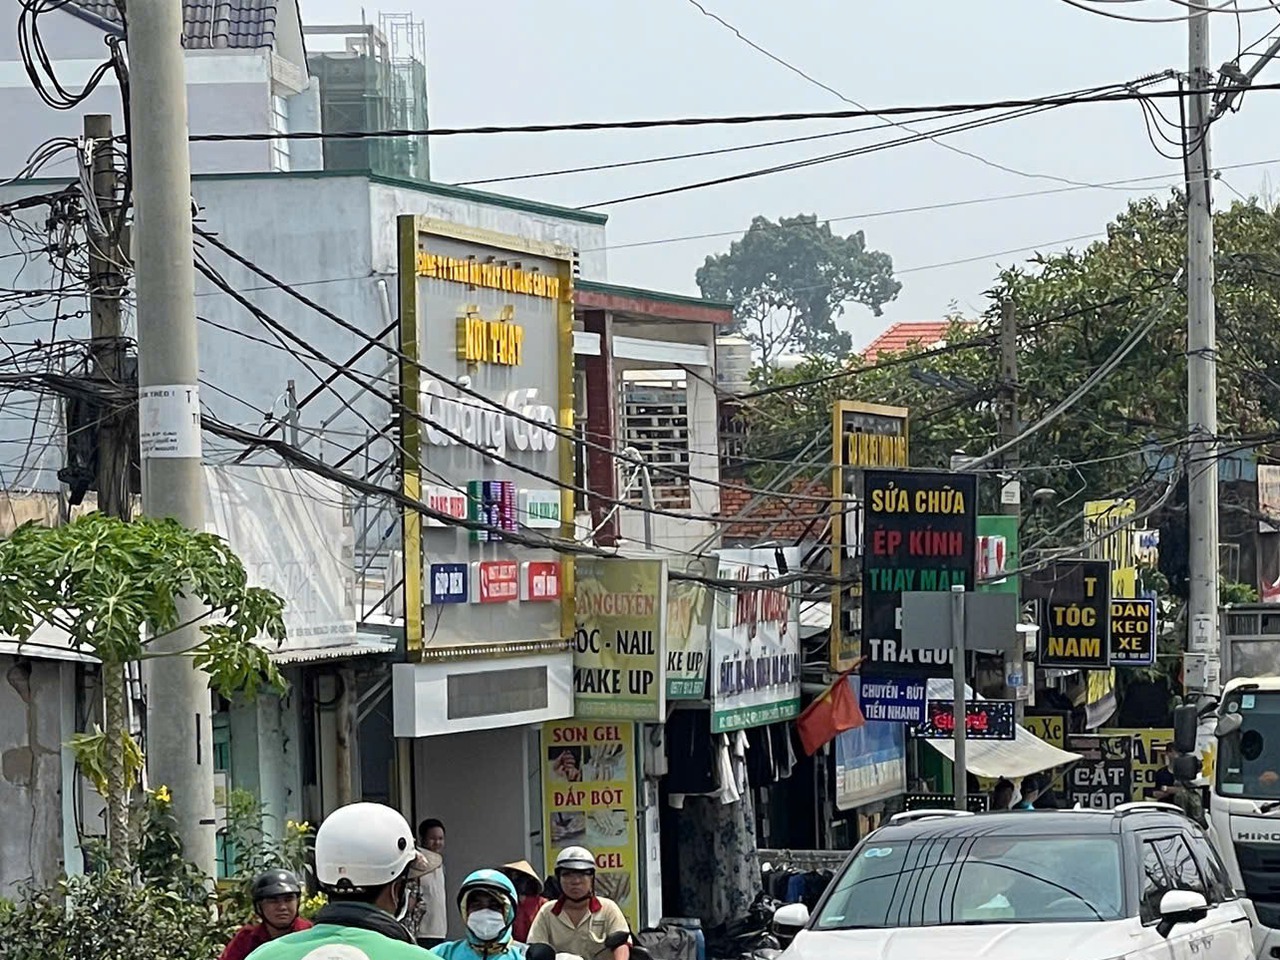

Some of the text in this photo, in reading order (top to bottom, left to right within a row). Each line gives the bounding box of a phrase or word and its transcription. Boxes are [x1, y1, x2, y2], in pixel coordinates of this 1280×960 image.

[872, 481, 965, 513] SỬA CHỮA
[873, 524, 901, 556] ÉP
[909, 524, 962, 556] KÍNH
[869, 568, 915, 591] THAY
[1054, 603, 1096, 627] TÓC
[1112, 620, 1148, 633] KEO
[575, 623, 600, 653] ÓC
[616, 630, 655, 655] NAIL
[1049, 638, 1100, 657] NAM
[1118, 637, 1142, 650] XE
[629, 670, 653, 694] UP
[906, 683, 924, 700] RÚT
[888, 705, 920, 721] NHANH
[553, 726, 622, 742] SƠN GEL
[1074, 762, 1125, 786] CẮT
[591, 786, 623, 808] BỘT
[595, 853, 623, 869] GEL
